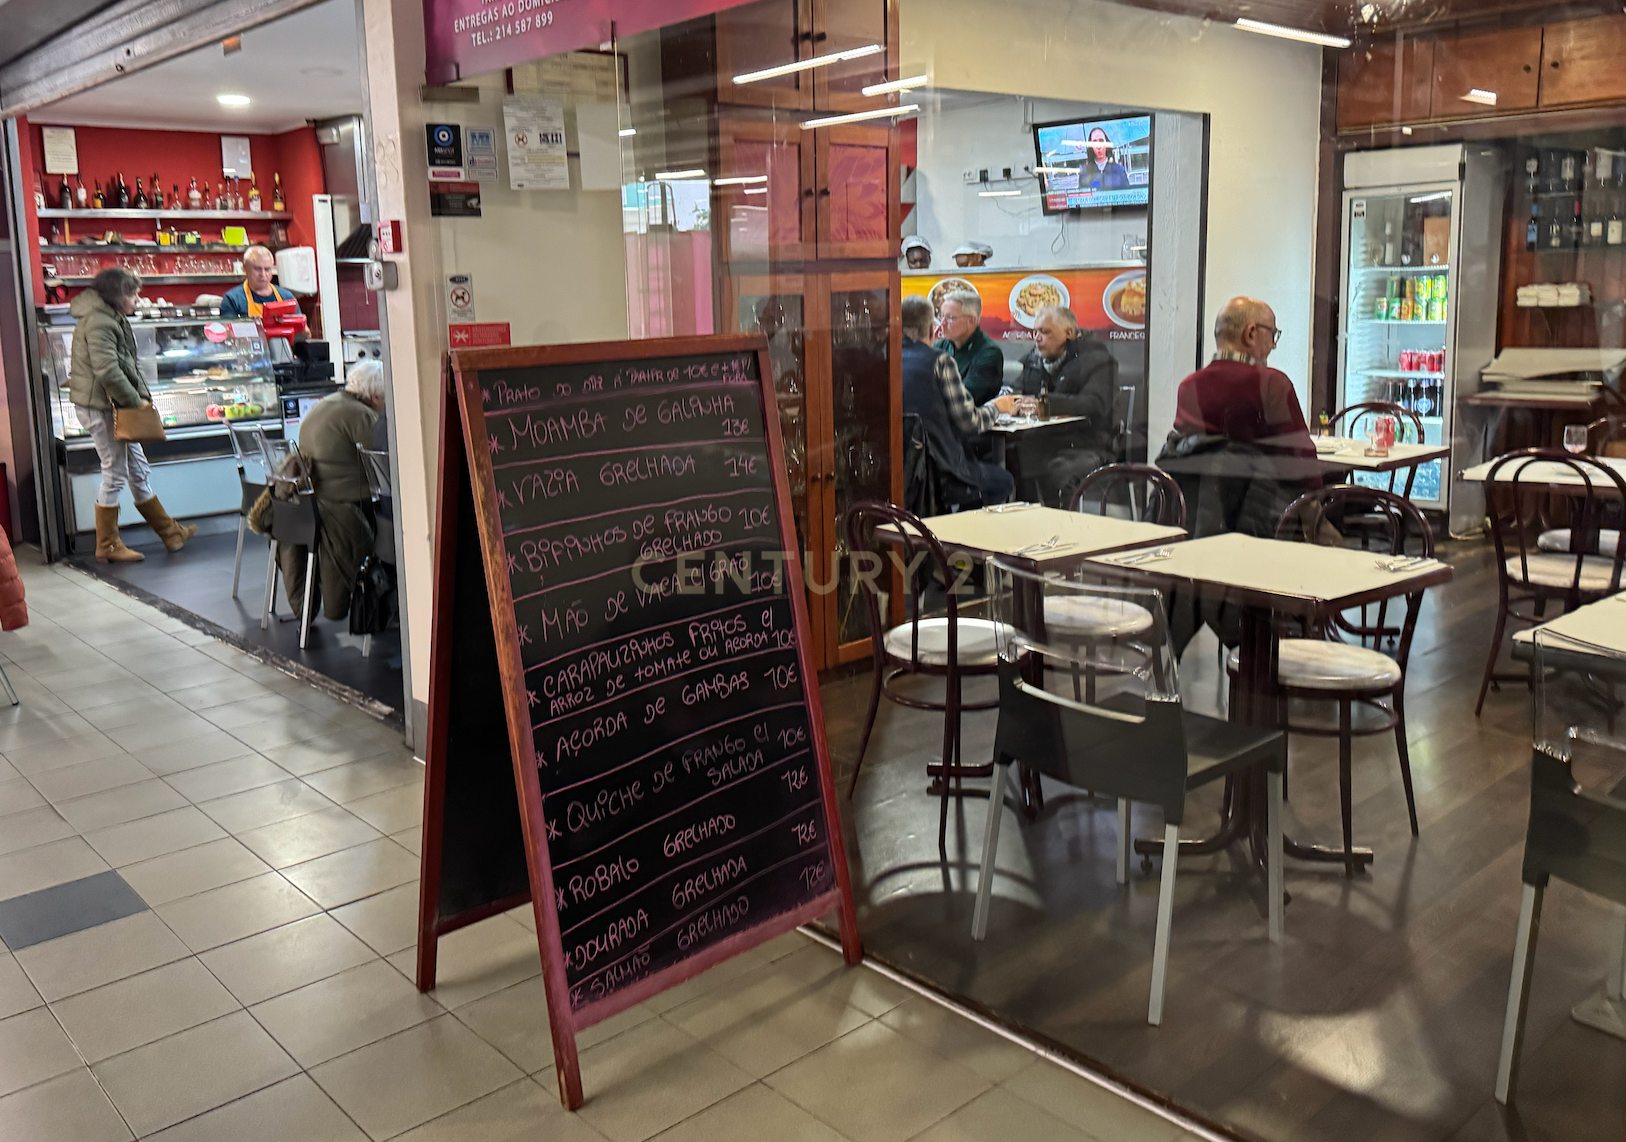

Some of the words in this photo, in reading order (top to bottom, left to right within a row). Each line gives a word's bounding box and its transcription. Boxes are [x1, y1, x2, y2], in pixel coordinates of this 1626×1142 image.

[454, 7, 499, 33] ENTREGAS
[501, 3, 515, 18] AO
[471, 30, 493, 48] TEL.:
[495, 21, 512, 40] 214
[515, 17, 532, 35] 587
[535, 10, 553, 28] 899
[508, 408, 608, 450] MOAMBA
[657, 393, 735, 424] GALINHA
[722, 417, 750, 436] 13€
[724, 455, 757, 477] 14€
[664, 503, 732, 534] FRANGO
[738, 504, 771, 530] 10€
[541, 599, 588, 643] MÃO
[635, 572, 682, 608] VACA
[543, 631, 674, 699] CARAPAUZINHOS
[550, 686, 595, 717] ARROZ
[698, 643, 719, 661] OU
[556, 711, 628, 762] AÇORDA
[681, 671, 750, 706] GAMBAS
[764, 662, 798, 690] 10€
[681, 734, 747, 774] FRANGO
[777, 726, 807, 749] 10€
[707, 749, 765, 787] SALADA
[781, 764, 809, 793] 12€
[575, 908, 649, 971] DOURADA
[791, 819, 817, 847] 12€
